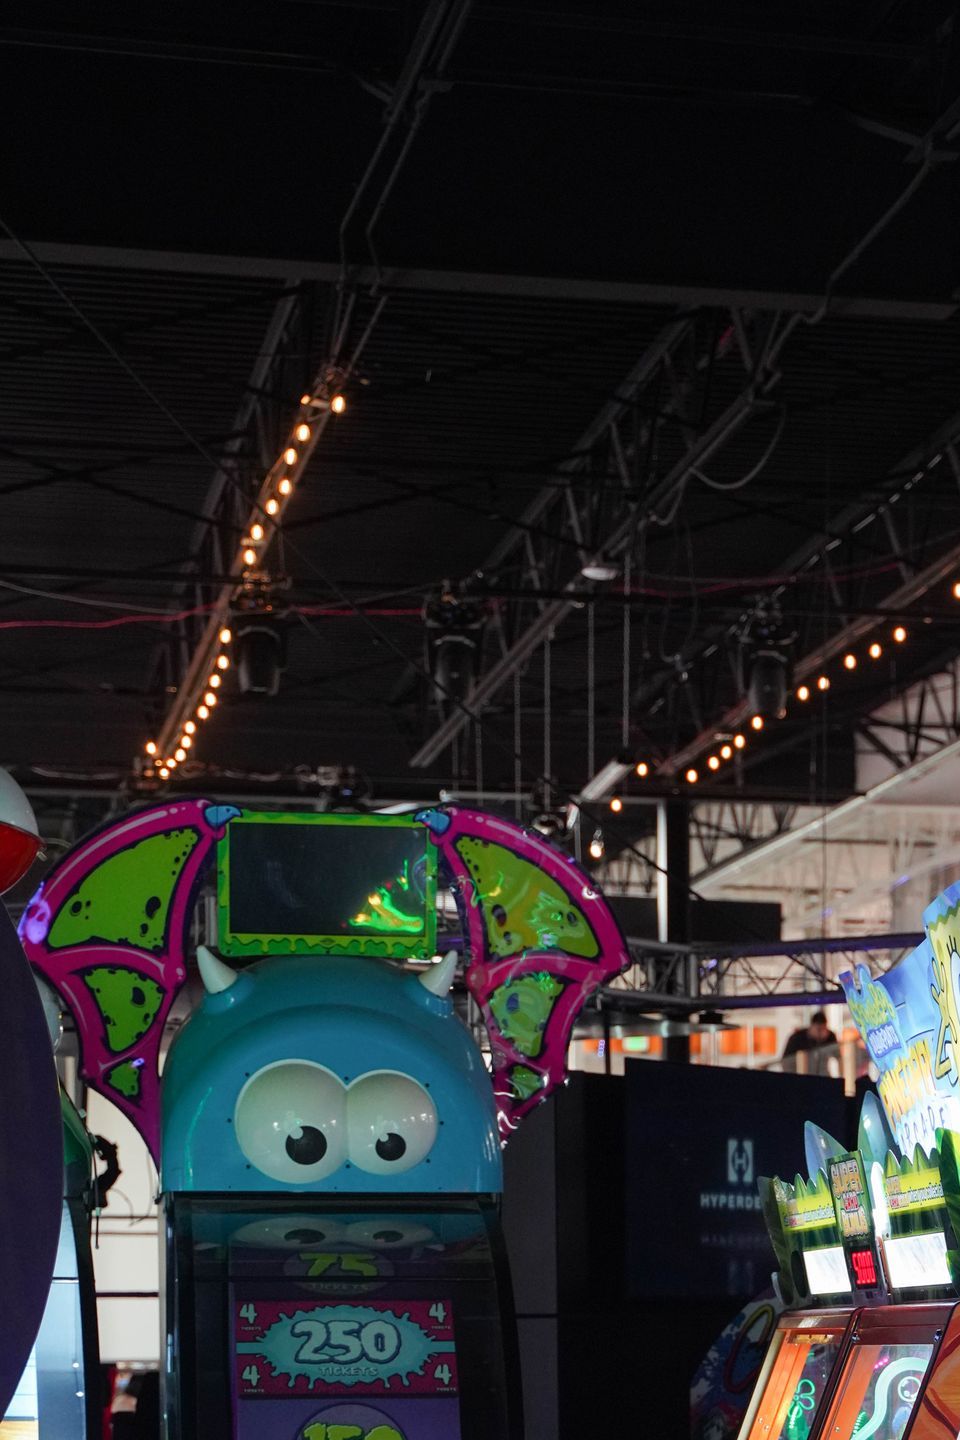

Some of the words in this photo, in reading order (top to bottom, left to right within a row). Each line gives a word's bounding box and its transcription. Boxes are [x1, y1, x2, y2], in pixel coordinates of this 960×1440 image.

[239, 1302, 258, 1324] 4
[428, 1301, 447, 1323] 4
[290, 1318, 401, 1364] 250
[241, 1364, 261, 1387] 4
[318, 1365, 379, 1377] TICKETS
[433, 1363, 453, 1385] 4
